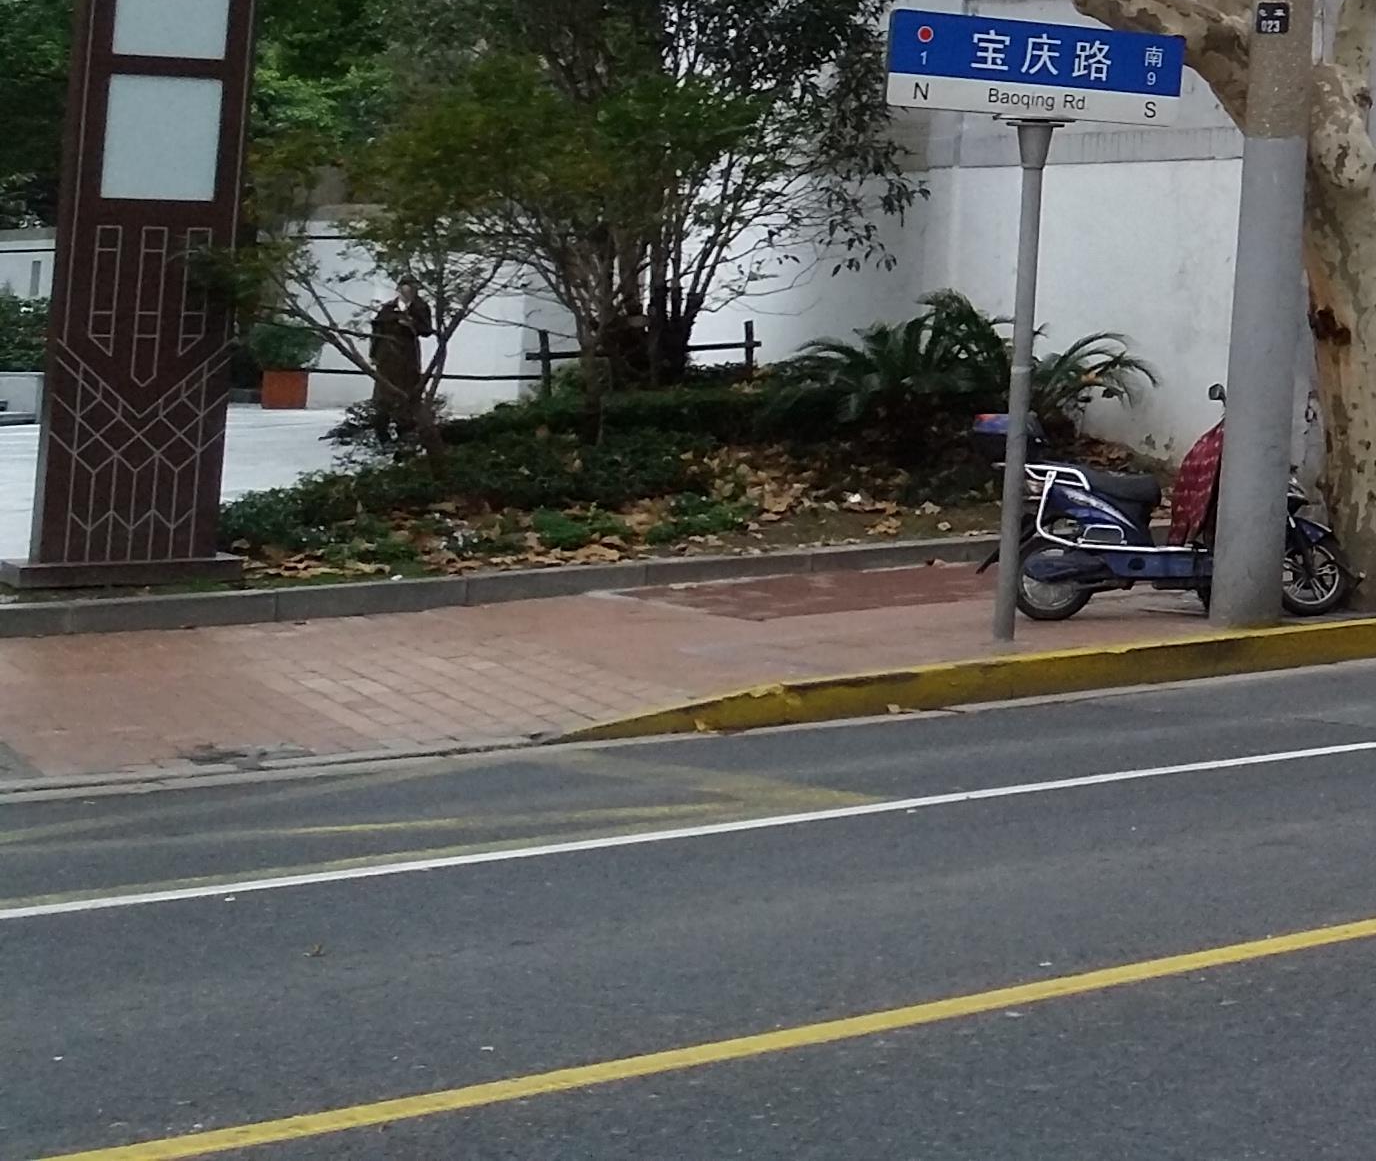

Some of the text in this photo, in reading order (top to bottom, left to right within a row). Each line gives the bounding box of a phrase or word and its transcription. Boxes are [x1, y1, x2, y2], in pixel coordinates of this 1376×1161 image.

[1261, 20, 1280, 33] 023
[920, 51, 928, 65] 1
[970, 29, 1112, 82] 宝庆路
[1144, 46, 1164, 68] 南
[1146, 72, 1156, 86] 9
[913, 82, 930, 100] N
[988, 88, 1086, 111] Baoqing Rd
[1144, 101, 1157, 118] S
